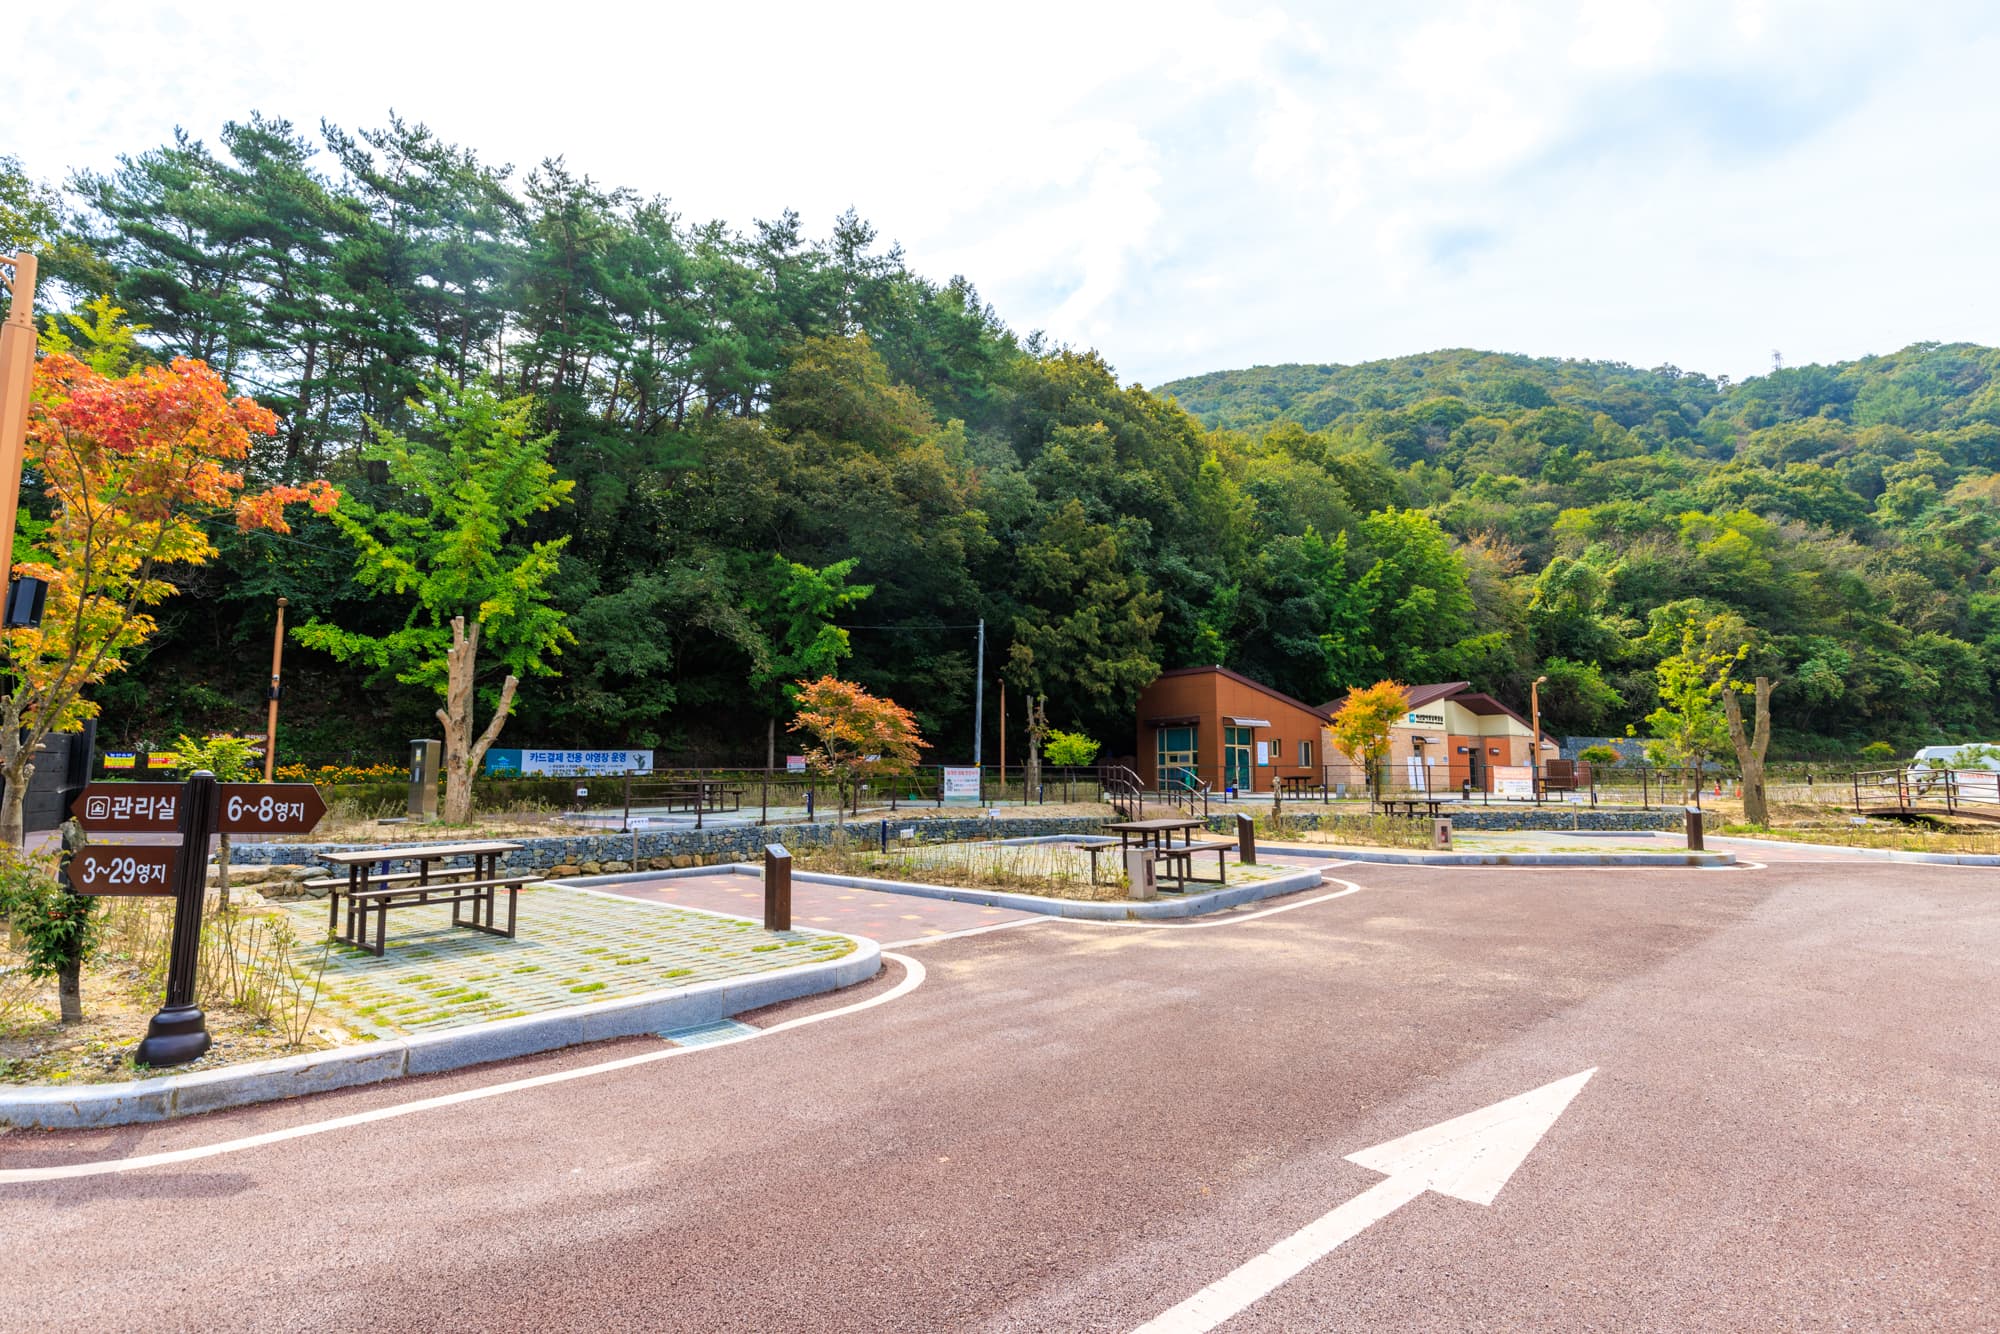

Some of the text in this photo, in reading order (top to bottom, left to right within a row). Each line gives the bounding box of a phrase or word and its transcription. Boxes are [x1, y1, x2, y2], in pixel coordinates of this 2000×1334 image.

[530, 752, 627, 763] 카드결제 전용 야영장 운영
[111, 796, 176, 820] 관리실
[227, 796, 305, 823] 6~8영지
[82, 857, 167, 884] 3~29영지
